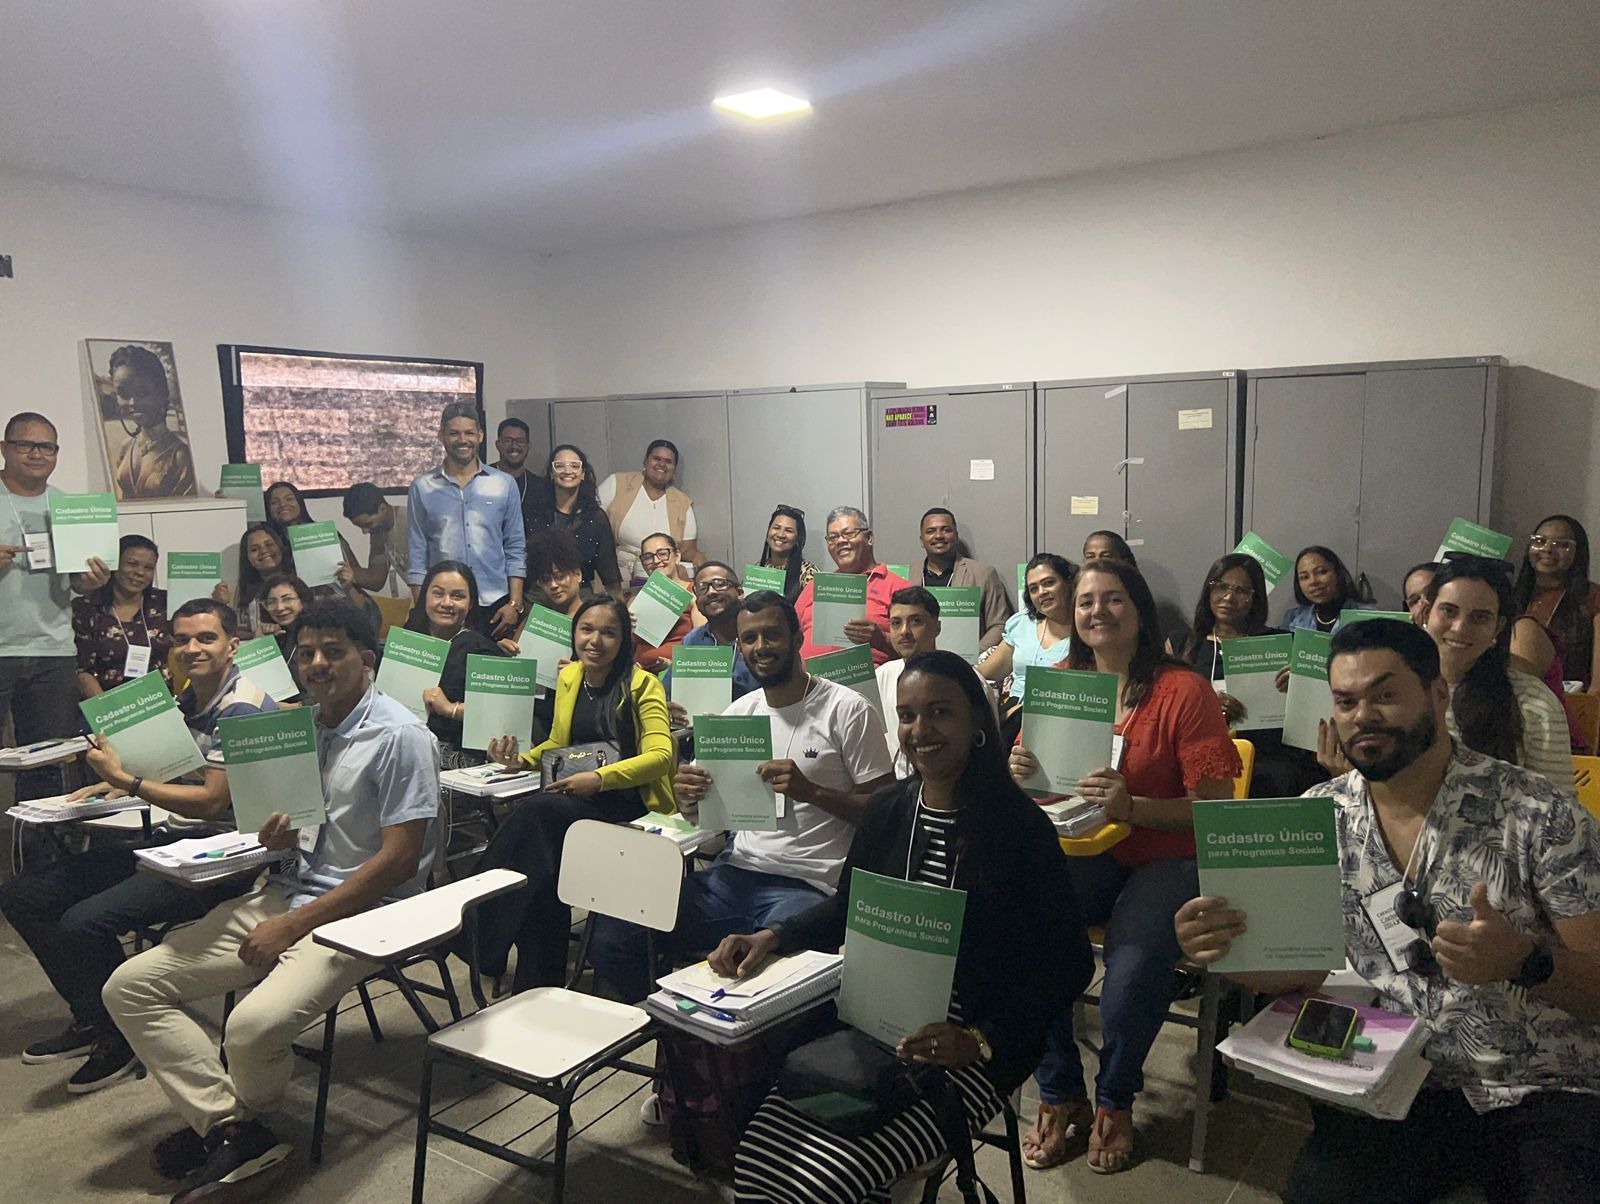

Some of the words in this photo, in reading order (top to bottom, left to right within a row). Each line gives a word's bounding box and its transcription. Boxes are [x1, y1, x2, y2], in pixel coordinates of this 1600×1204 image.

[845, 584, 862, 593] Único
[390, 642, 420, 655] Cadastro
[422, 650, 441, 661] Único
[1229, 653, 1262, 662] Cadastro
[1265, 651, 1288, 659] Único
[1298, 651, 1328, 663] Cadas
[848, 663, 869, 671] Único
[471, 672, 505, 681] Cadastro
[507, 673, 530, 683] Único
[1032, 688, 1076, 701] Cadastro
[1079, 691, 1109, 704] Único
[96, 702, 136, 724] Cadastro
[137, 691, 163, 705] Único
[1046, 702, 1081, 711] Programas
[1084, 706, 1107, 714] Sociais
[228, 735, 274, 748] Cadastro
[276, 729, 307, 740] Único
[700, 736, 738, 744] Cadastro
[740, 734, 765, 744] Único
[1207, 832, 1274, 844] Cadastro
[1279, 826, 1324, 842] Único
[1208, 849, 1230, 859] para
[1232, 848, 1286, 858] Programas
[1288, 845, 1325, 855] Sociais
[856, 900, 912, 924] Cadastro
[915, 912, 952, 931] Único
[855, 915, 871, 926] para
[872, 920, 917, 938] Programas
[919, 932, 949, 944] Sociais
